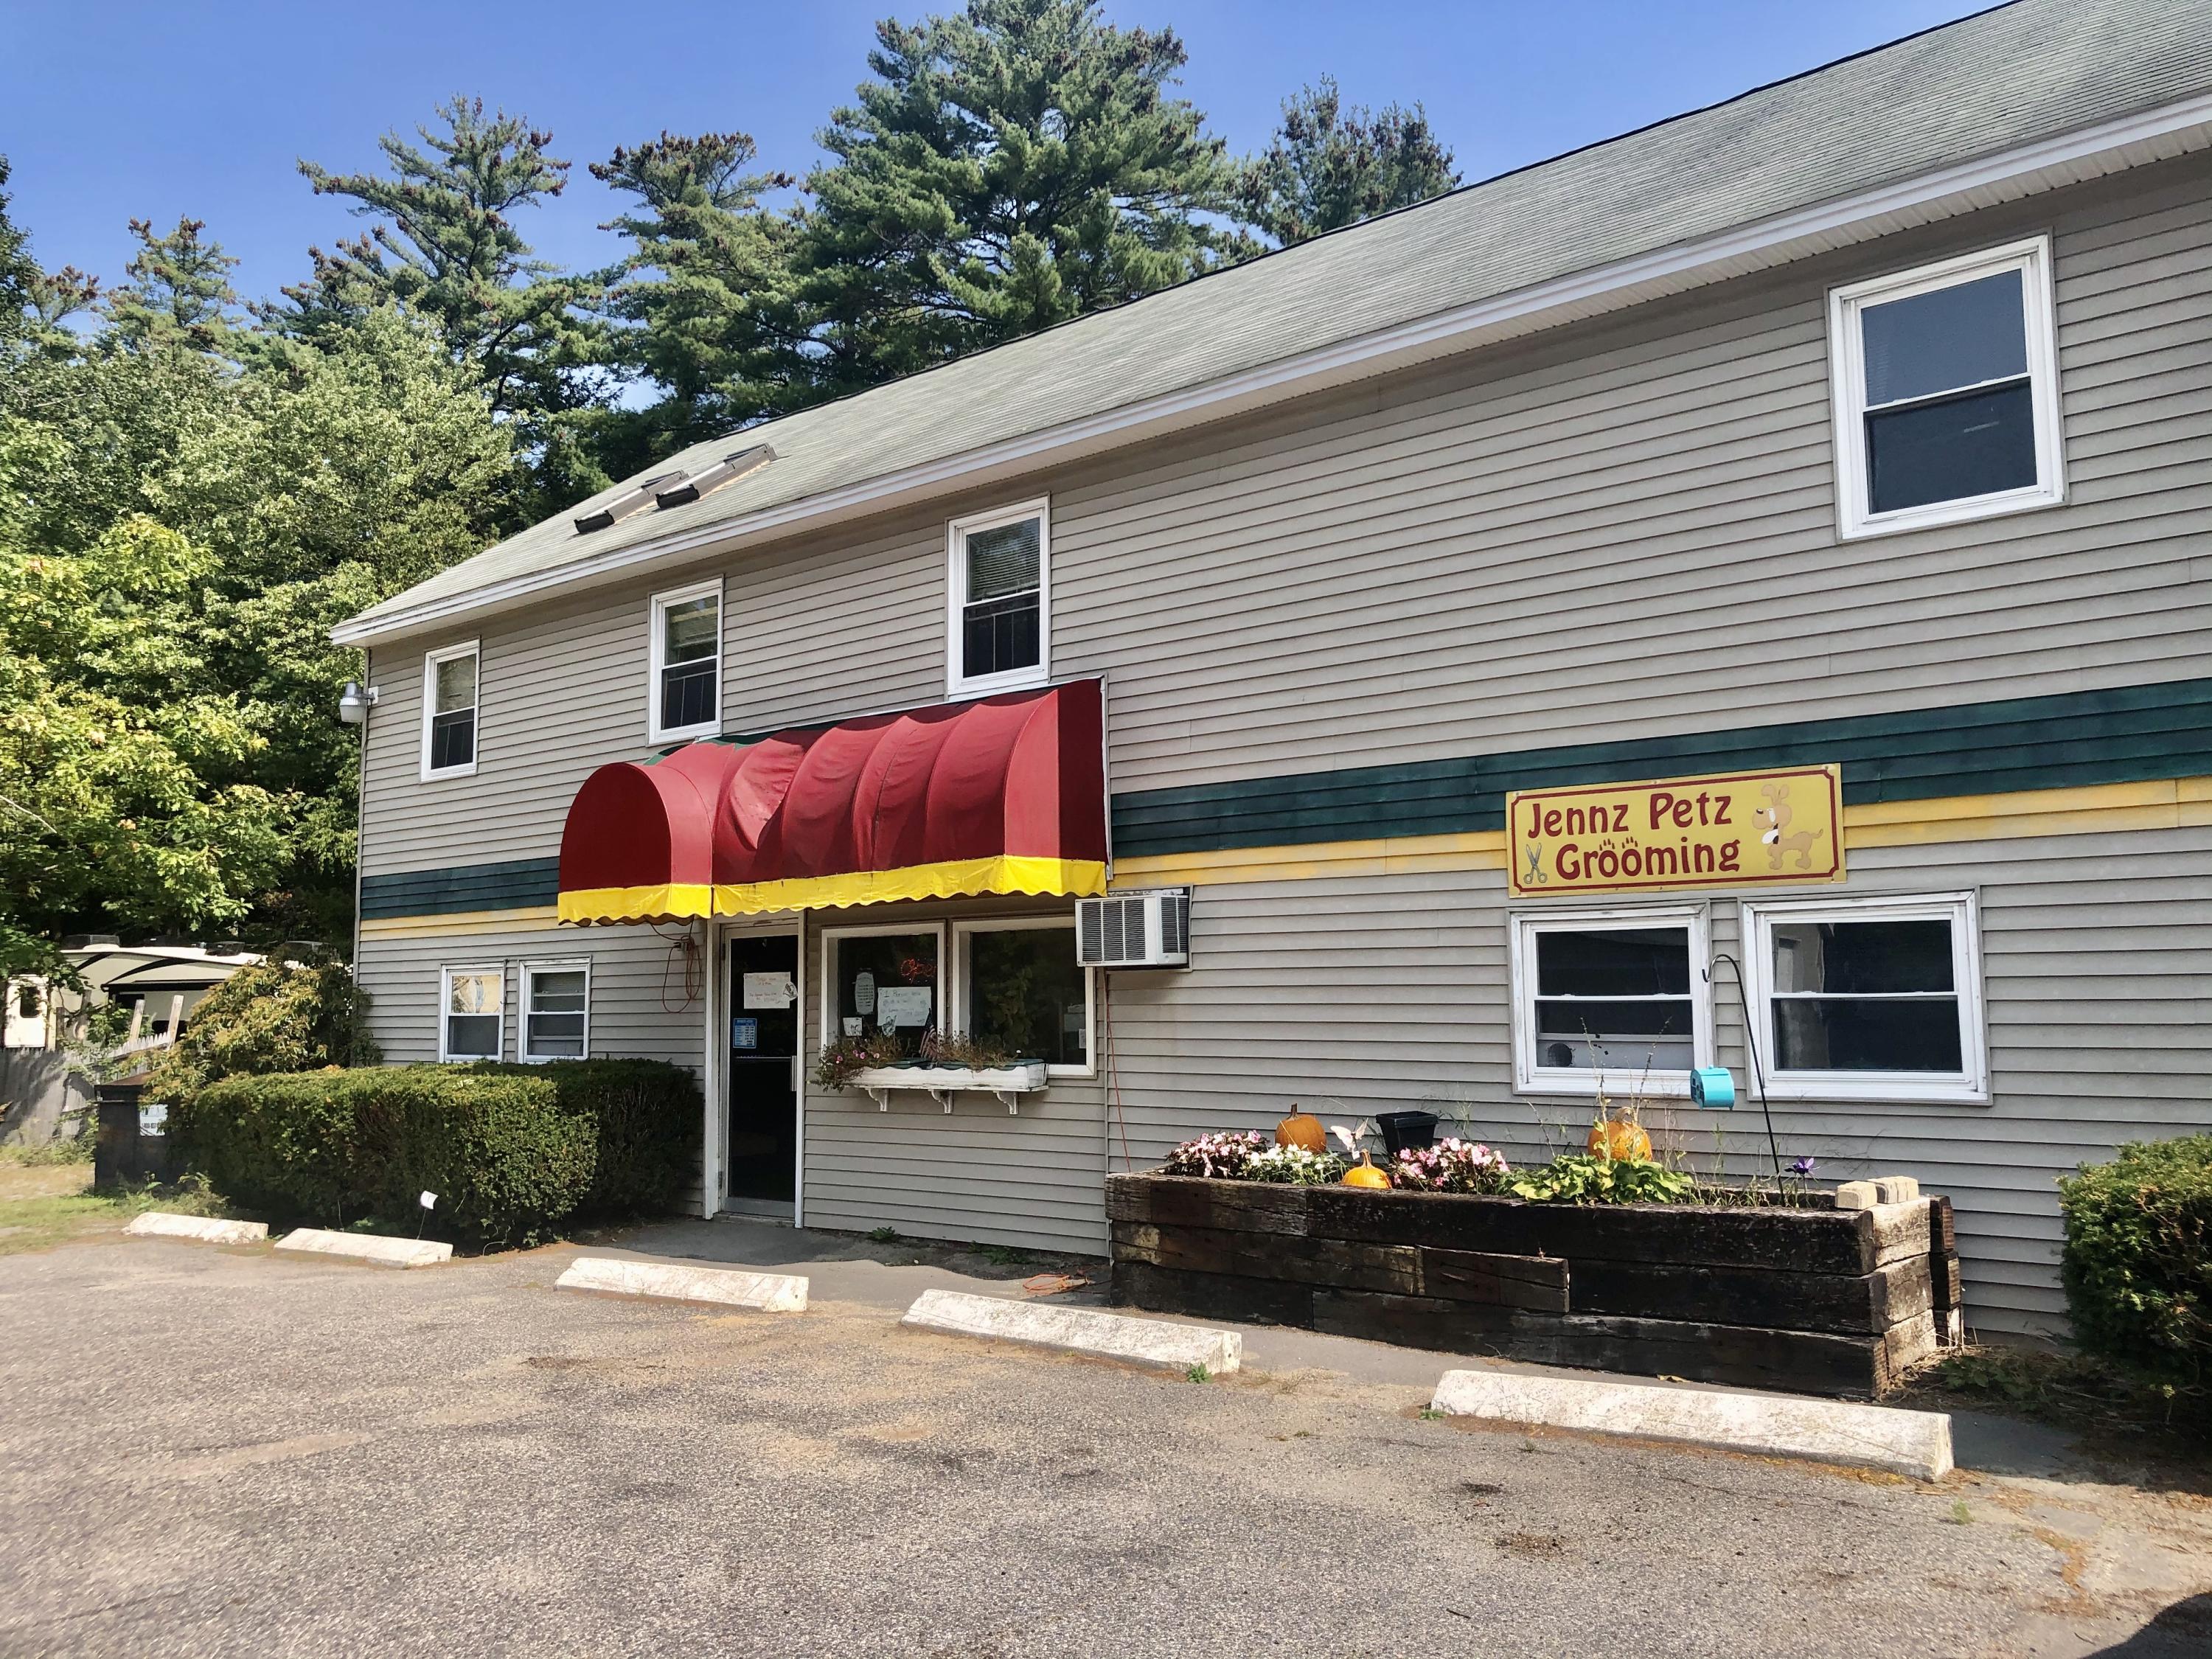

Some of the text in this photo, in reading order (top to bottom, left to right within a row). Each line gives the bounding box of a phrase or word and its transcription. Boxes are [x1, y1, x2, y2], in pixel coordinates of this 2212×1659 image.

[1527, 792, 1733, 839] Jennz Petz
[1556, 836, 1741, 880] Grooming
